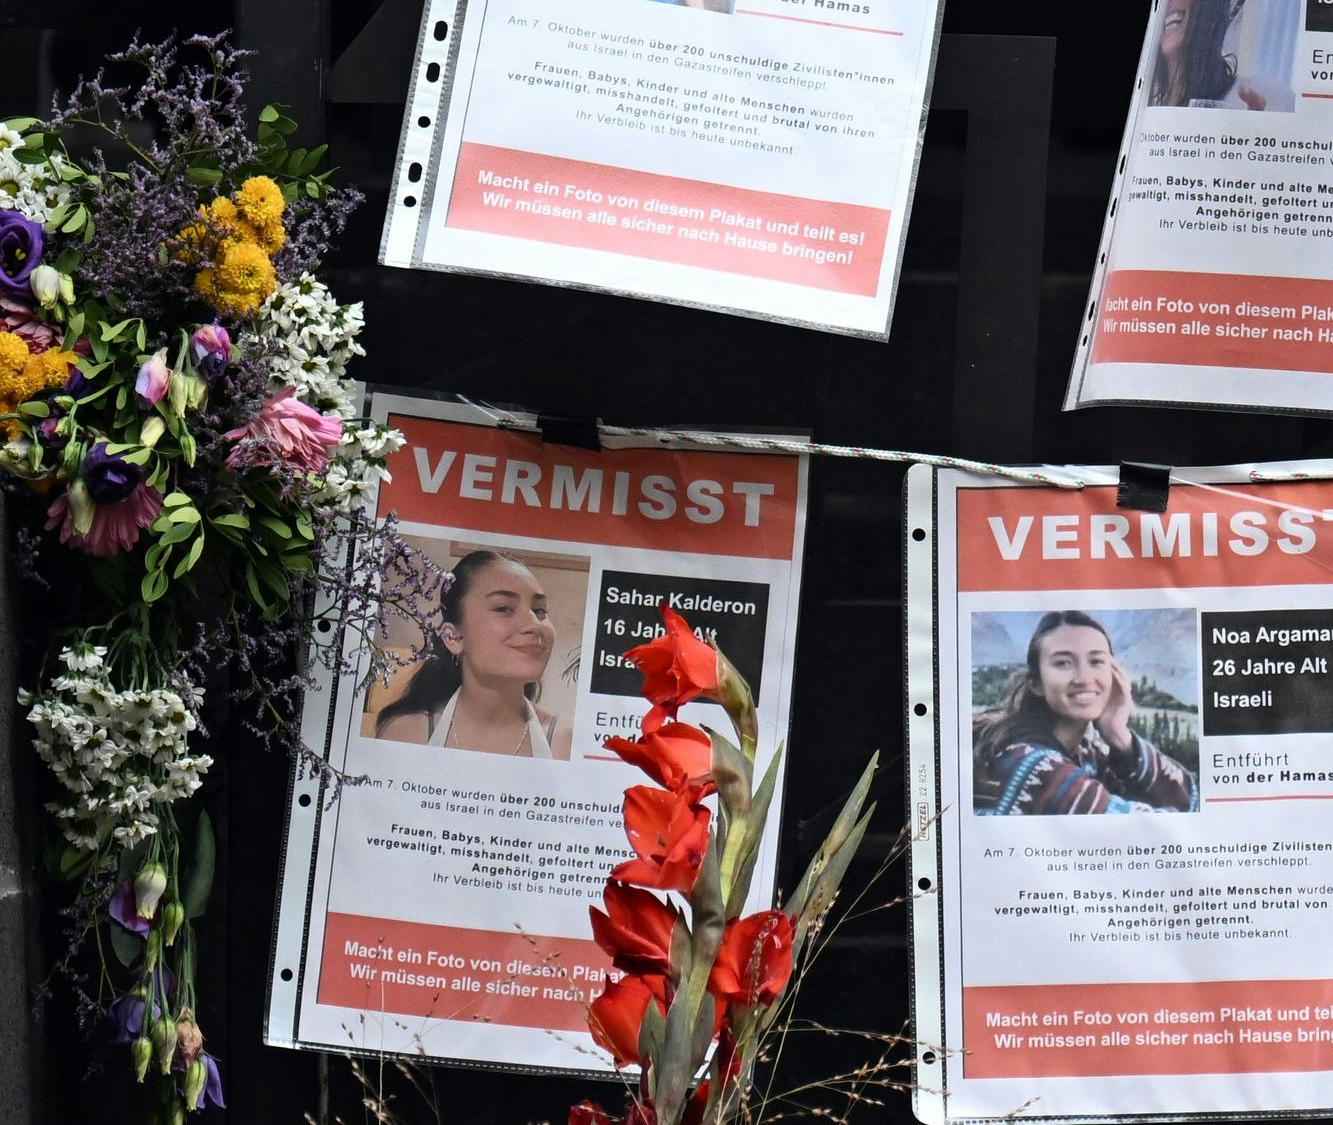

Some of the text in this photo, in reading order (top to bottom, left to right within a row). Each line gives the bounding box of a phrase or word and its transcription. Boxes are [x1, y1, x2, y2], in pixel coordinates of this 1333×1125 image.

[482, 191, 853, 265] Wir müssen alle sicher nach Hause bringen!
[412, 447, 775, 527] VERMISST
[606, 586, 756, 615] Sahar Kalderon
[603, 618, 626, 636] 16
[631, 621, 666, 639] Jah
[1212, 627, 1251, 645] Noa
[599, 649, 637, 669] Isra
[1212, 656, 1328, 676] 26 Jahre Alt
[1213, 689, 1272, 708] Israeli
[985, 1011, 1039, 1028] Macht
[1041, 1010, 1068, 1026] ein
[1073, 1009, 1112, 1025] Foto
[1116, 1011, 1149, 1024] von
[1152, 1008, 1215, 1024] diesem
[1220, 1006, 1273, 1022] Plakat
[1276, 1005, 1310, 1021] und
